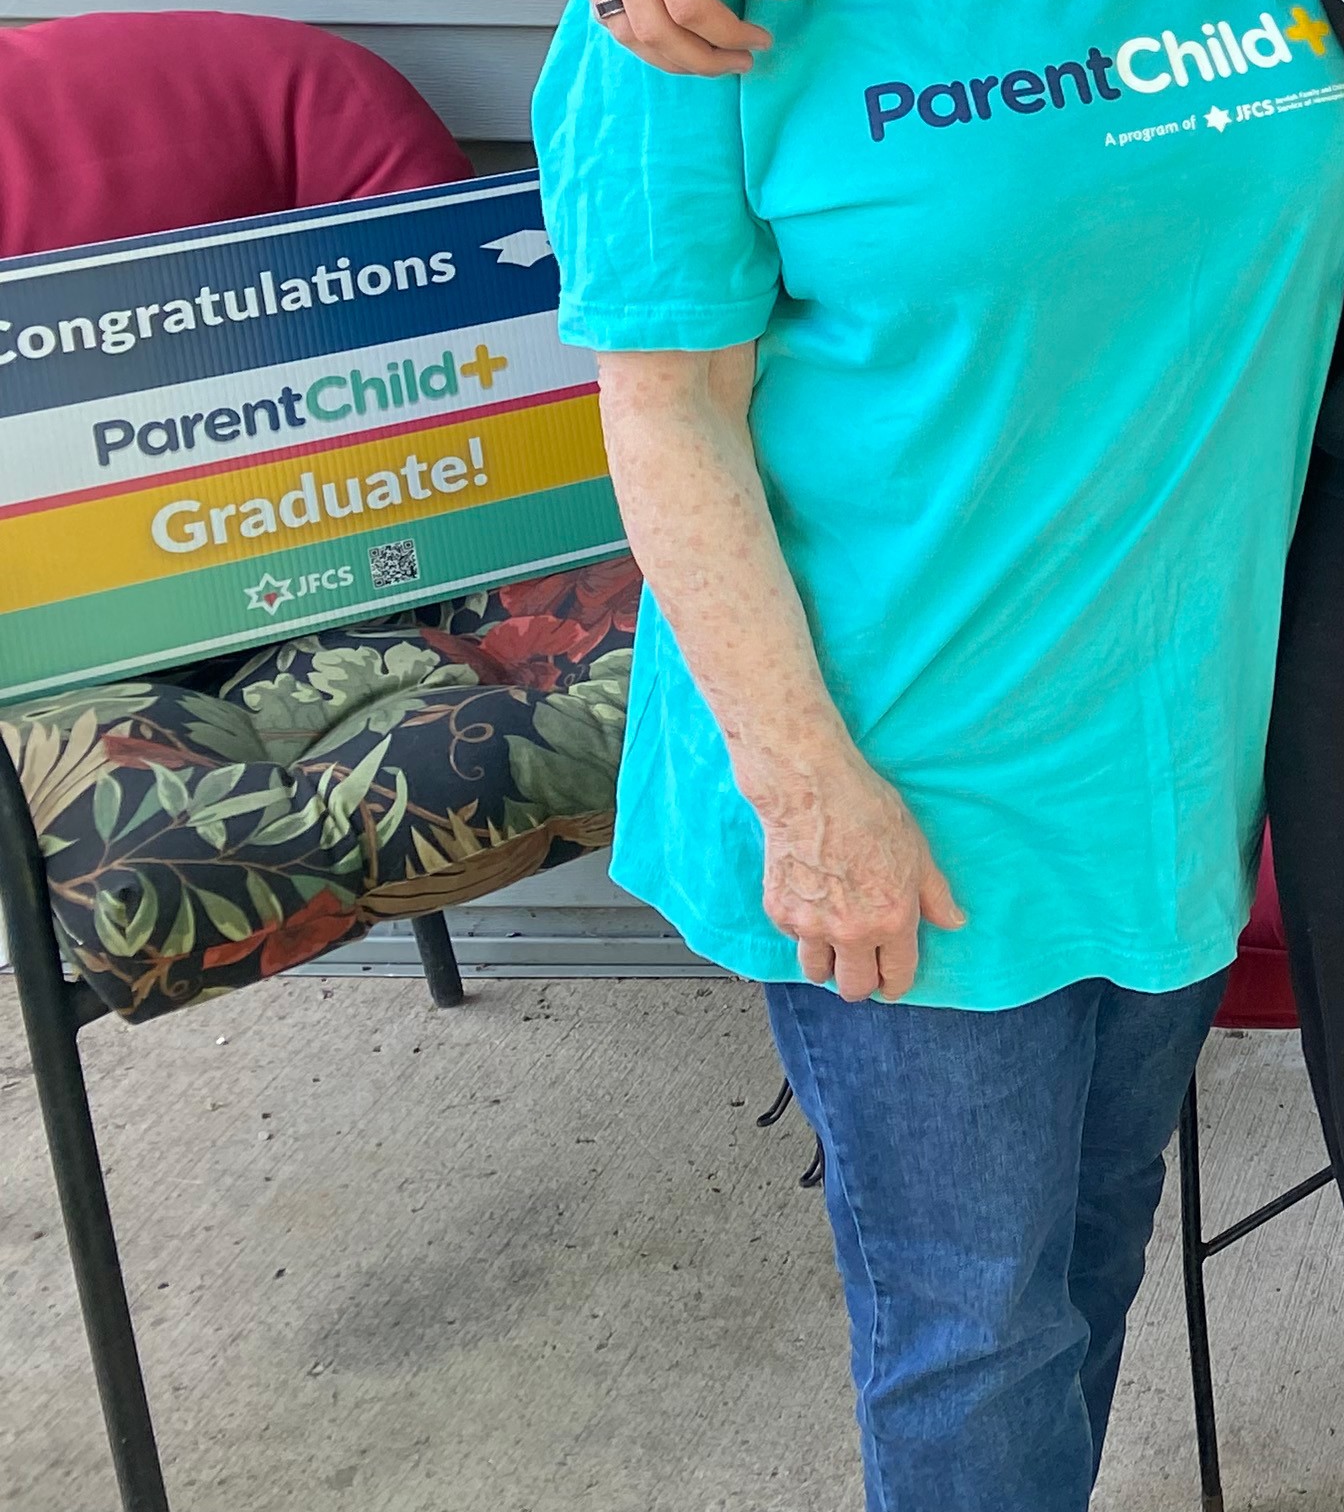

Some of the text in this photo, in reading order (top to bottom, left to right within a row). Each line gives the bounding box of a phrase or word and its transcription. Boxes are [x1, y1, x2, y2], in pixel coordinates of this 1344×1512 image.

[1104, 98, 1275, 147] A program of JFCS
[151, 436, 488, 554] Graduate!
[297, 565, 355, 598] JFCS
